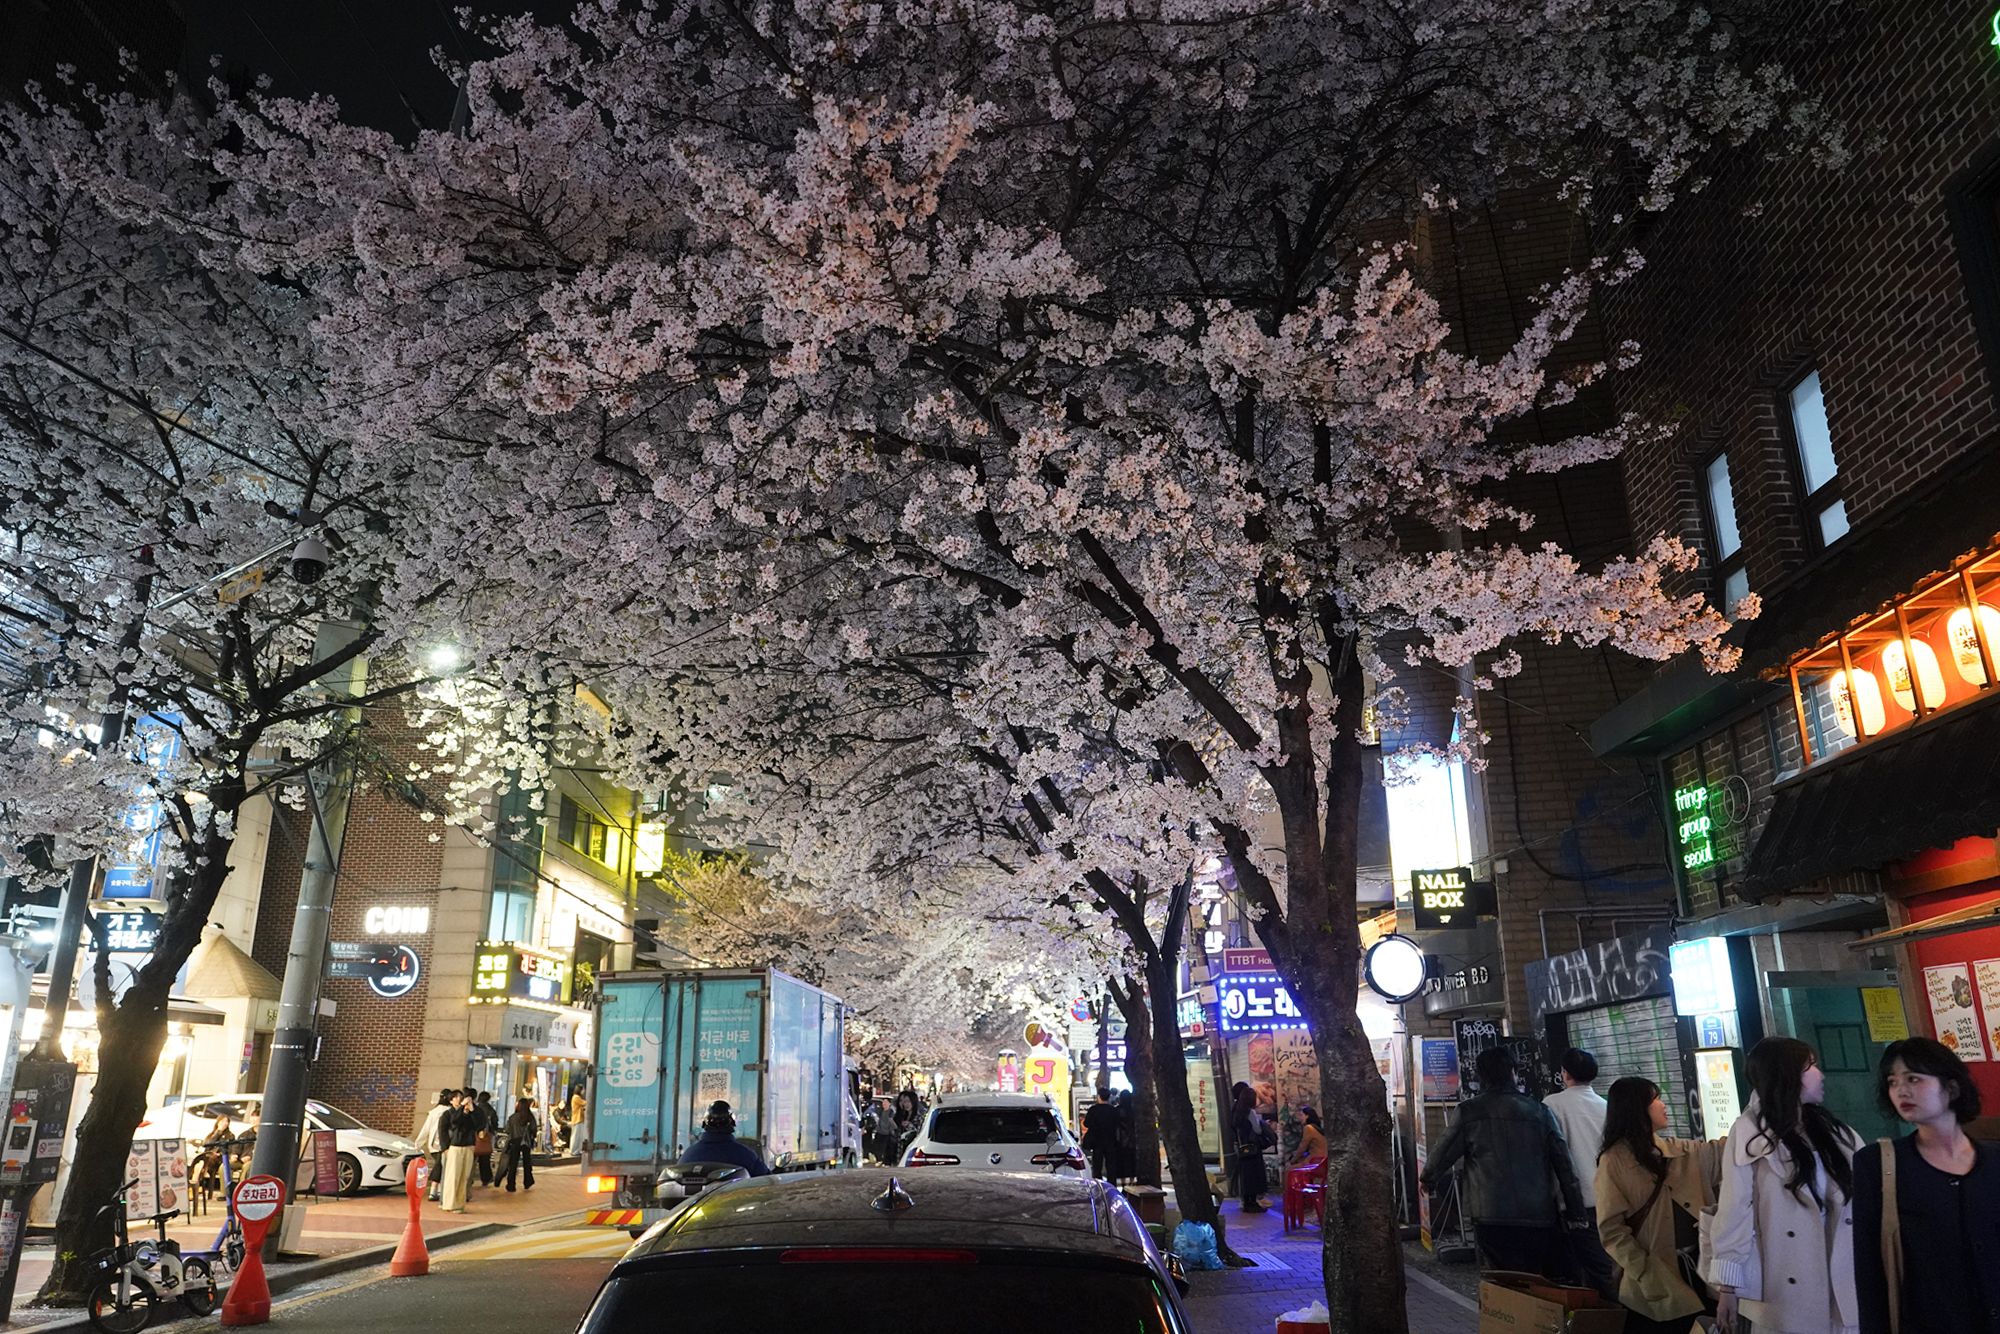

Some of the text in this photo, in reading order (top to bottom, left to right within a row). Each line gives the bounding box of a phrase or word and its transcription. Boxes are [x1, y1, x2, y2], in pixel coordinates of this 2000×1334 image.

[1675, 786, 1708, 811] fringe
[1679, 816, 1711, 844] group
[1683, 839, 1713, 869] seoul
[1418, 873, 1466, 890] NAIL
[1423, 891, 1465, 909] BOX
[107, 914, 144, 931] 기구
[365, 906, 430, 934] COIN
[1229, 955, 1256, 966] TTBT
[612, 1036, 642, 1053] 우리
[700, 1030, 751, 1045] 지금 바로
[1708, 1031, 1719, 1045] 79
[699, 1048, 738, 1062] 한 번에
[624, 1068, 643, 1081] GS
[1032, 1060, 1056, 1085] J
[602, 1108, 614, 1116] GS
[242, 1188, 277, 1200] 주차금지
